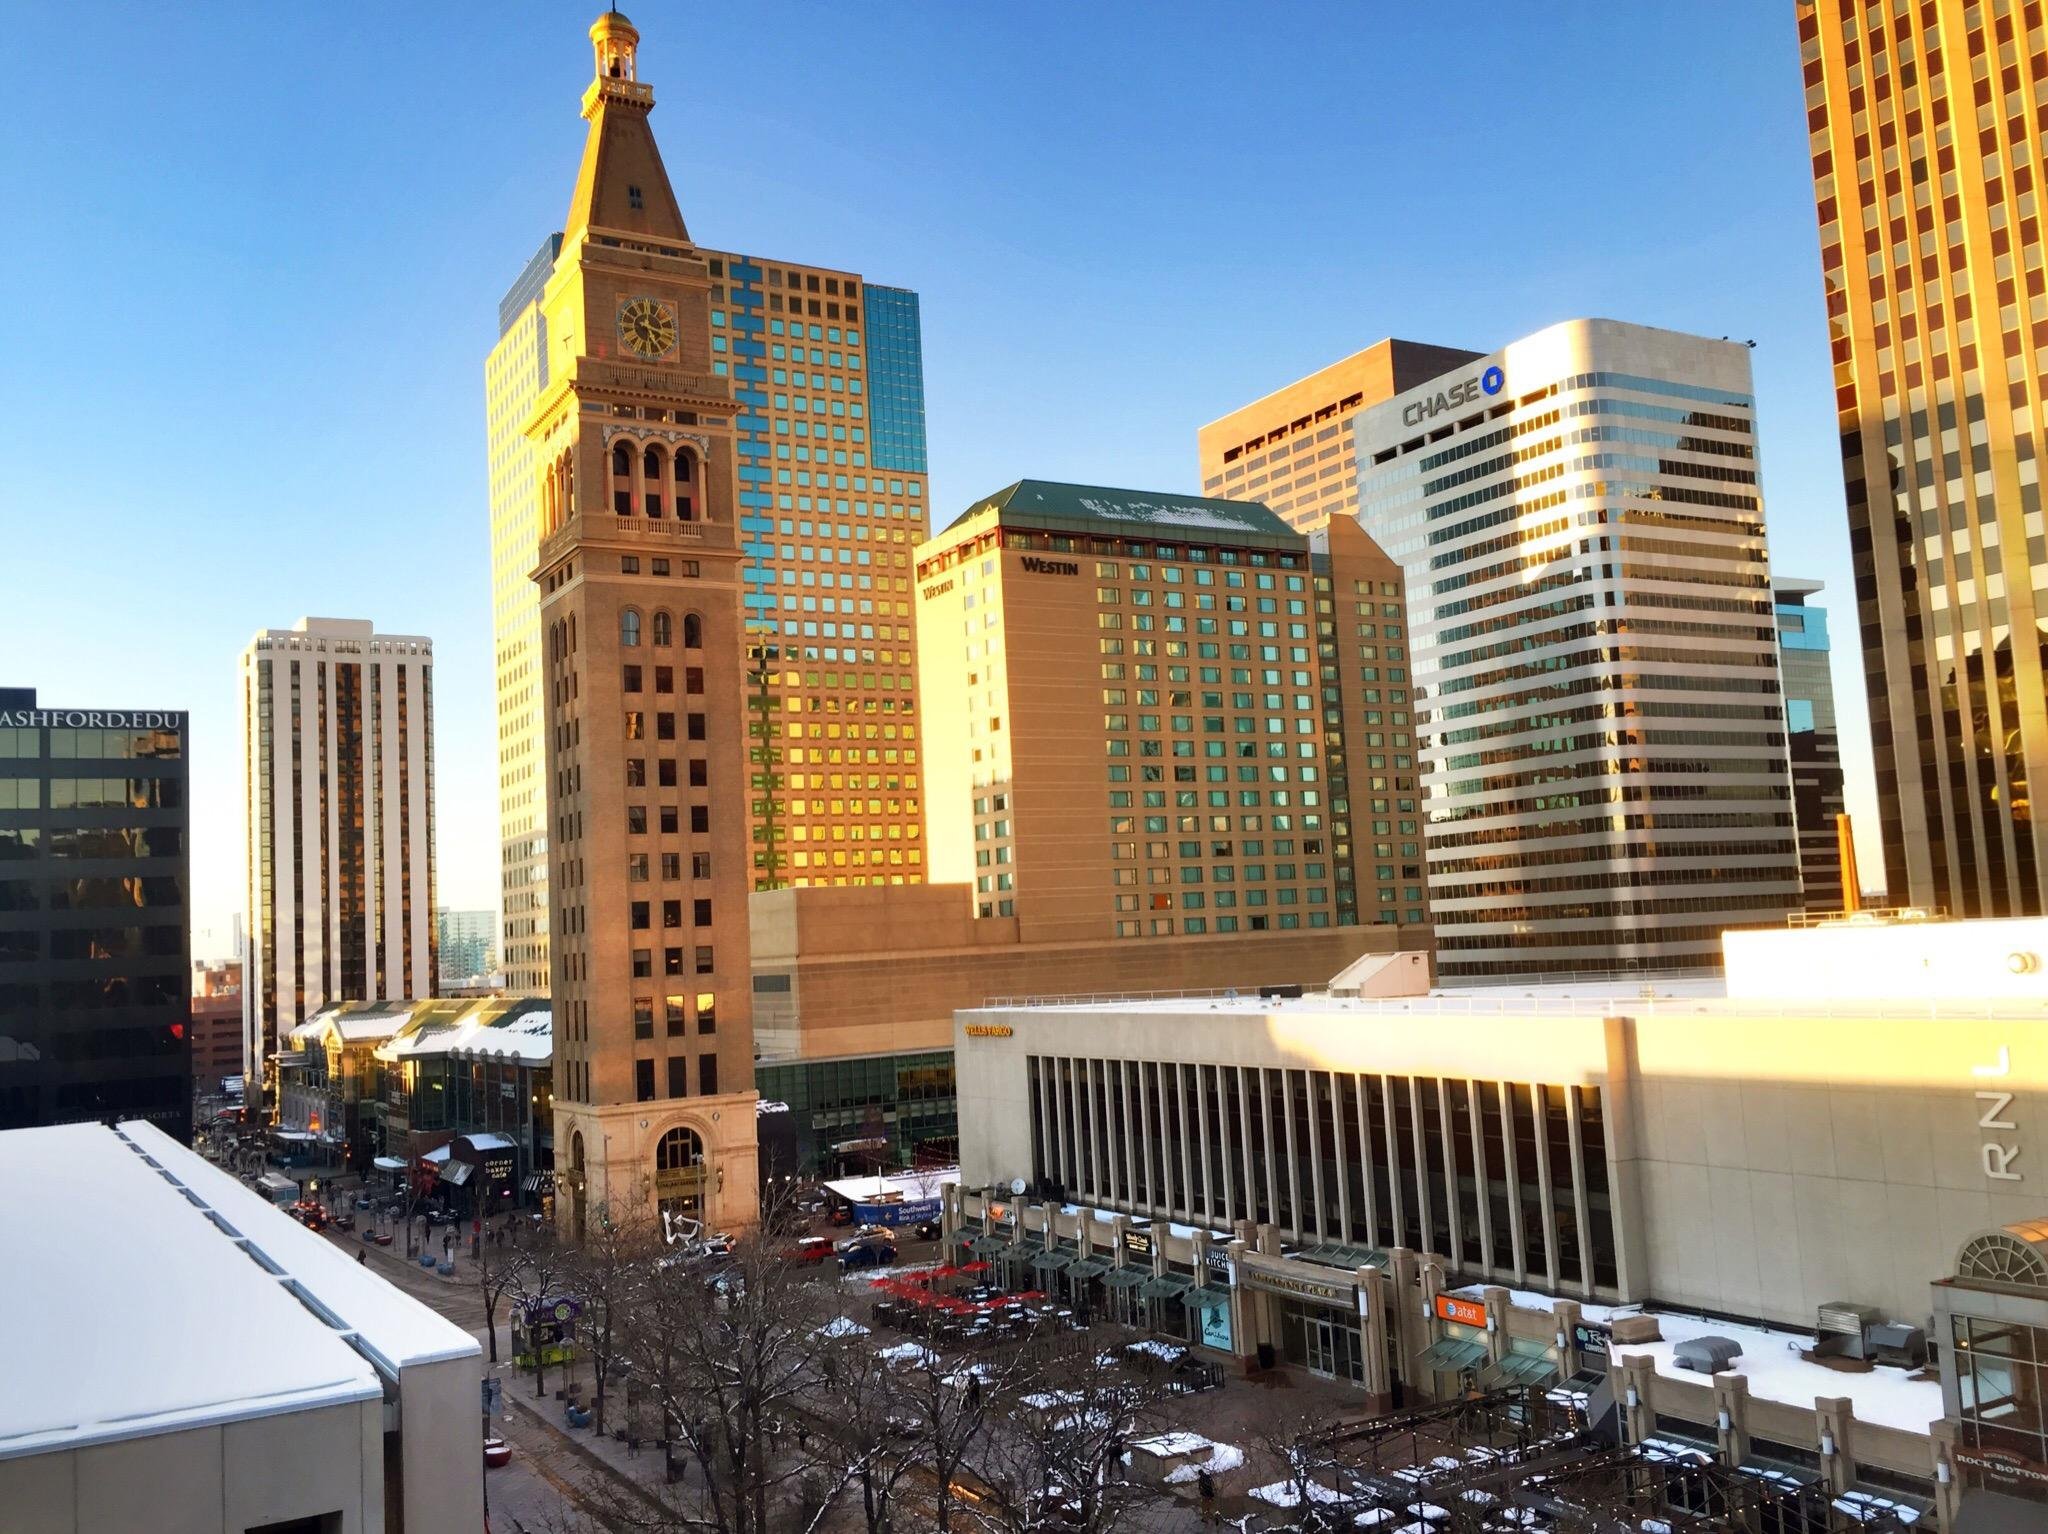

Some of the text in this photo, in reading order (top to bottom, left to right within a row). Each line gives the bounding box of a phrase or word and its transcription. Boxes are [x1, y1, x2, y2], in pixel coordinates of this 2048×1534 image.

[1402, 377, 1480, 427] CHASE
[0, 711, 180, 729] ASHFORD.EDU
[964, 1024, 1013, 1037] WELLS FARGO
[1972, 1044, 2023, 1181] RNL
[485, 1159, 513, 1167] corner
[485, 1166, 513, 1174] bakery
[898, 1203, 932, 1215] Southwest
[1210, 1250, 1229, 1261] JUICE
[1457, 1306, 1478, 1321] at&t
[1956, 1454, 1993, 1469] ROCK
